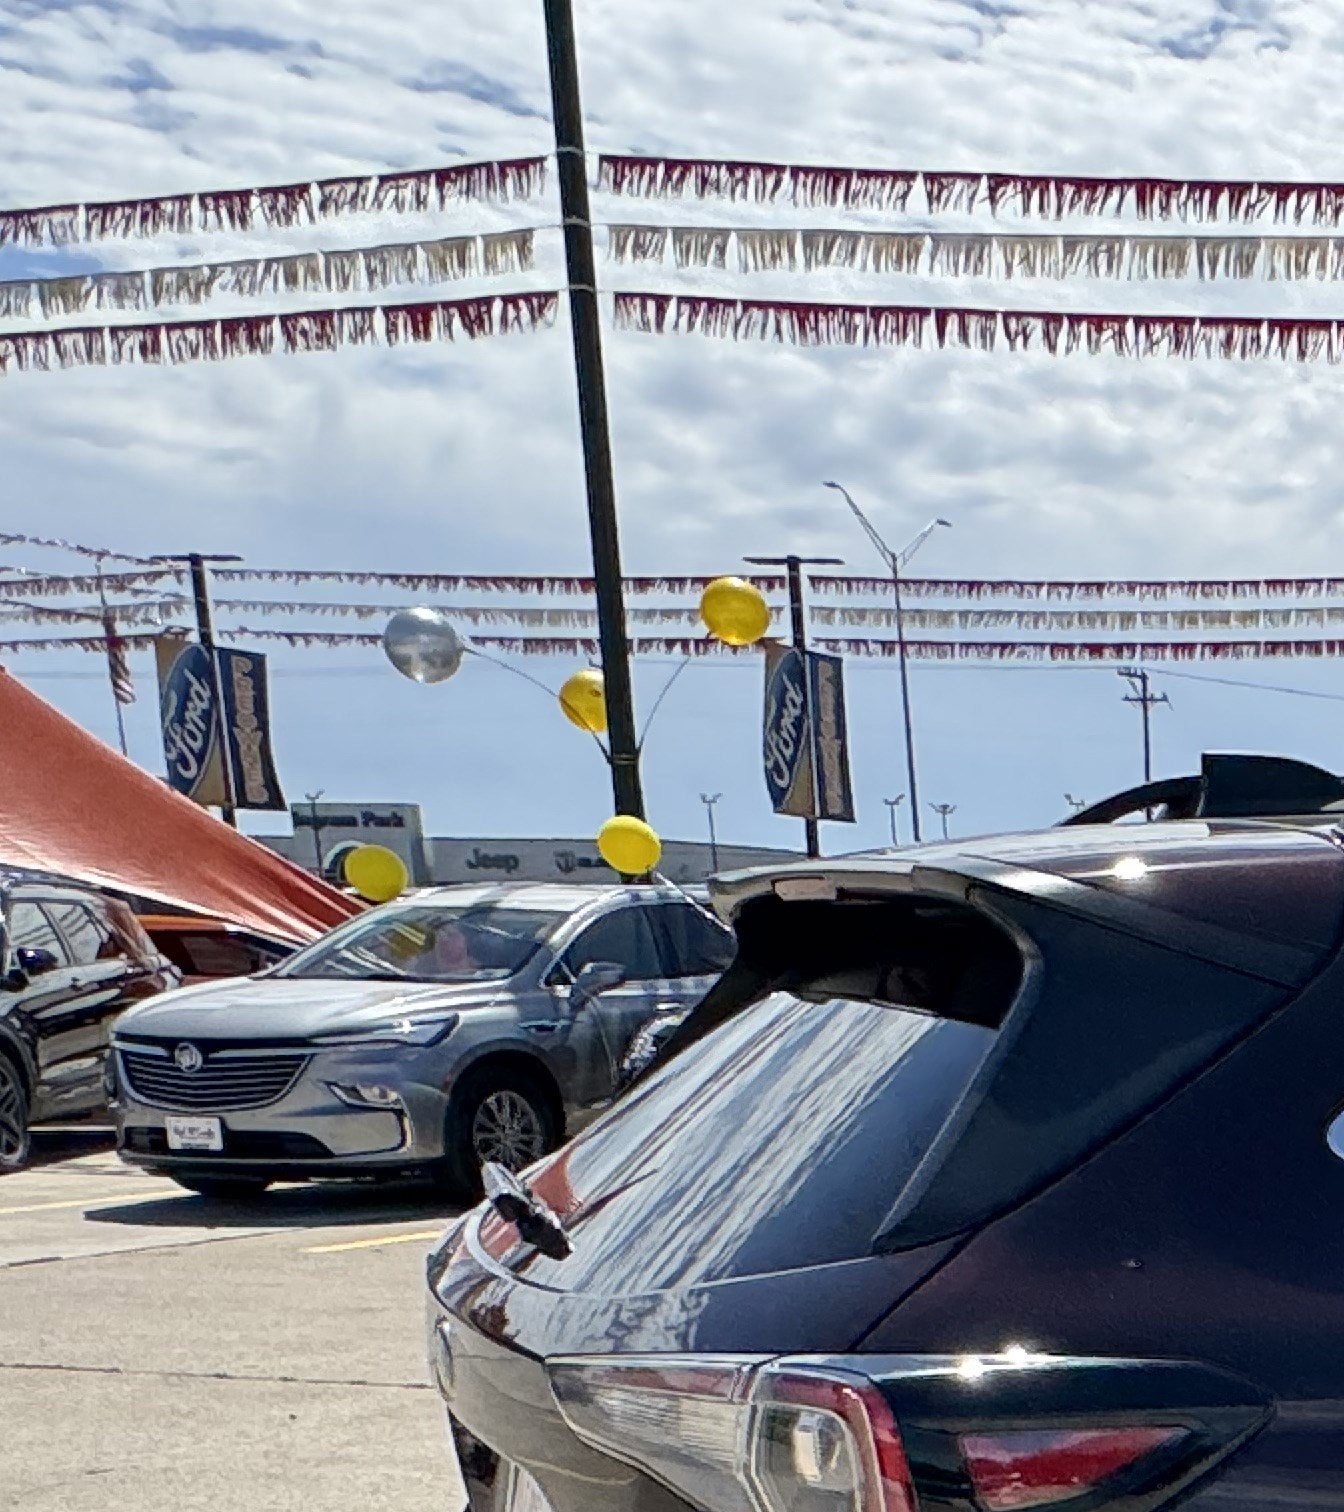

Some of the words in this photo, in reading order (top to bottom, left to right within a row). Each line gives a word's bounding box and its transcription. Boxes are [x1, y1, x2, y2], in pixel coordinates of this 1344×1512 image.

[163, 668, 212, 779] Ford
[765, 671, 804, 789] Ford
[465, 848, 520, 874] Jeep
